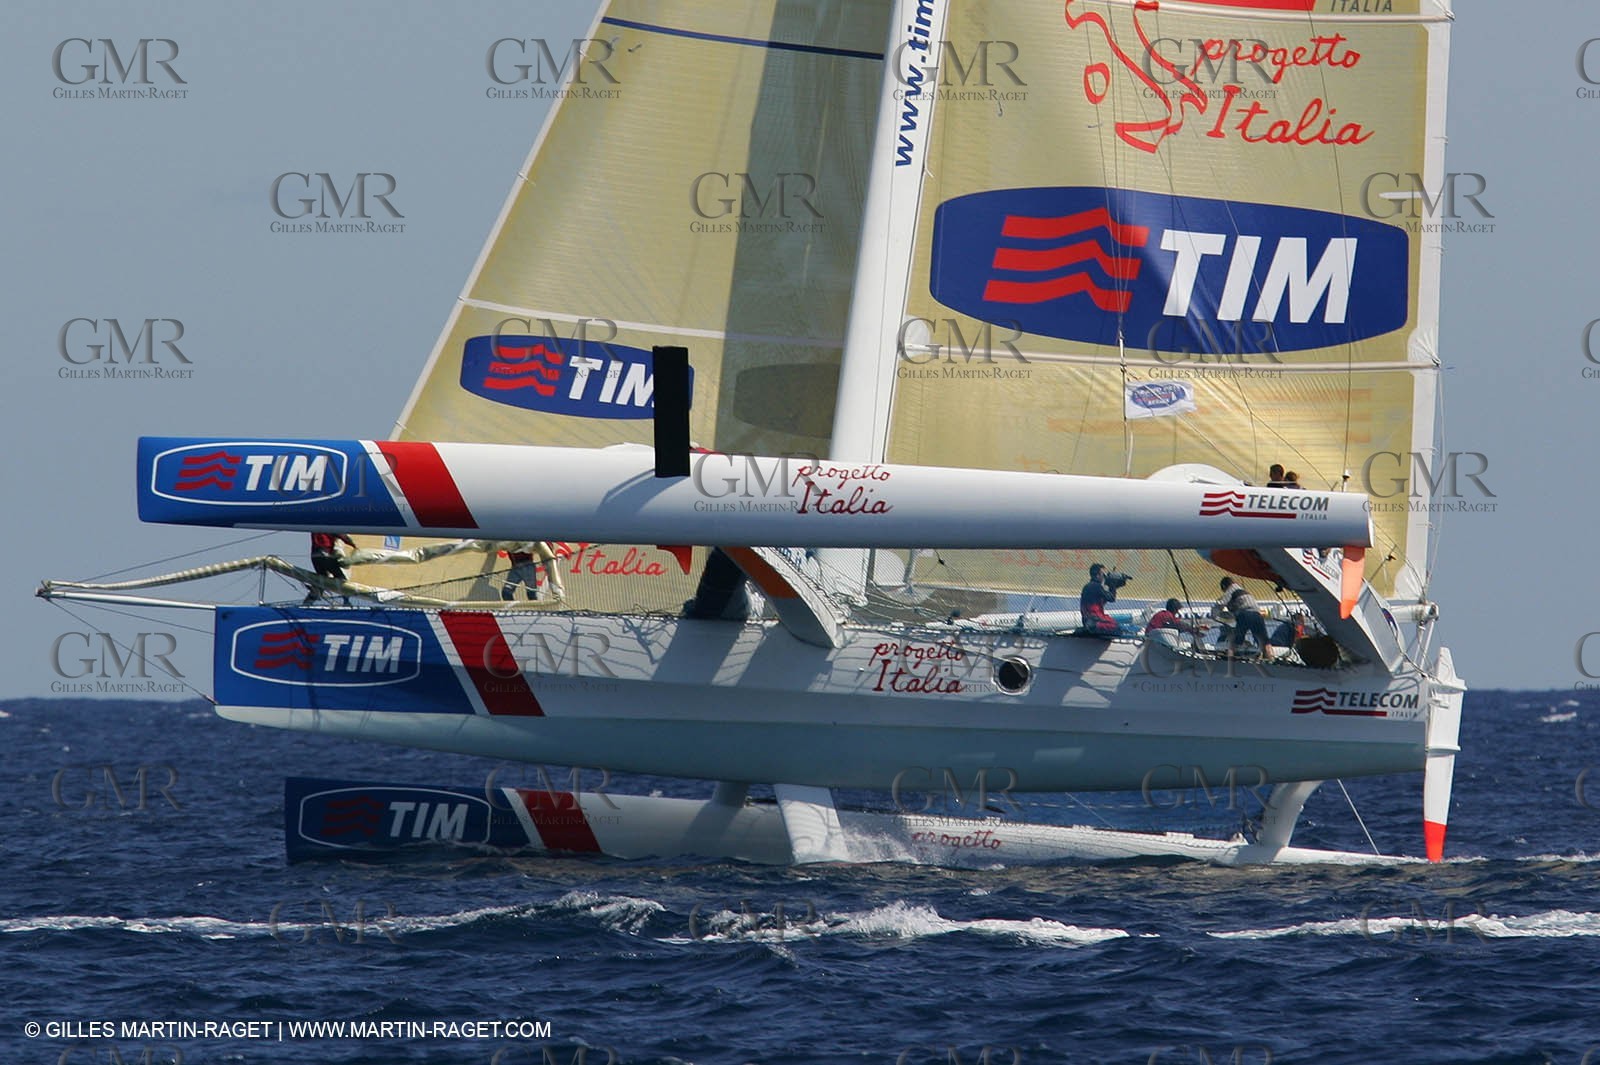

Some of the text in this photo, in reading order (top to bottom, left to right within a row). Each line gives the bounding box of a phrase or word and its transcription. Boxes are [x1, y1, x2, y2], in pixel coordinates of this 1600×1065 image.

[1330, 0, 1392, 12] ITALIA
[1190, 33, 1361, 84] progetto
[1206, 85, 1375, 145] Italia
[1160, 229, 1358, 324] TIM
[246, 455, 328, 491] TIM
[792, 465, 890, 489] progetto
[797, 481, 893, 514] Italia
[1248, 494, 1330, 511] TELECOM
[1301, 513, 1328, 521] ITALIA
[570, 543, 667, 575] Italia
[323, 634, 404, 673] TIM
[868, 640, 966, 668] progetto
[872, 659, 967, 693] Italia
[1339, 692, 1419, 709] TELECOM
[389, 802, 469, 840] TIM
